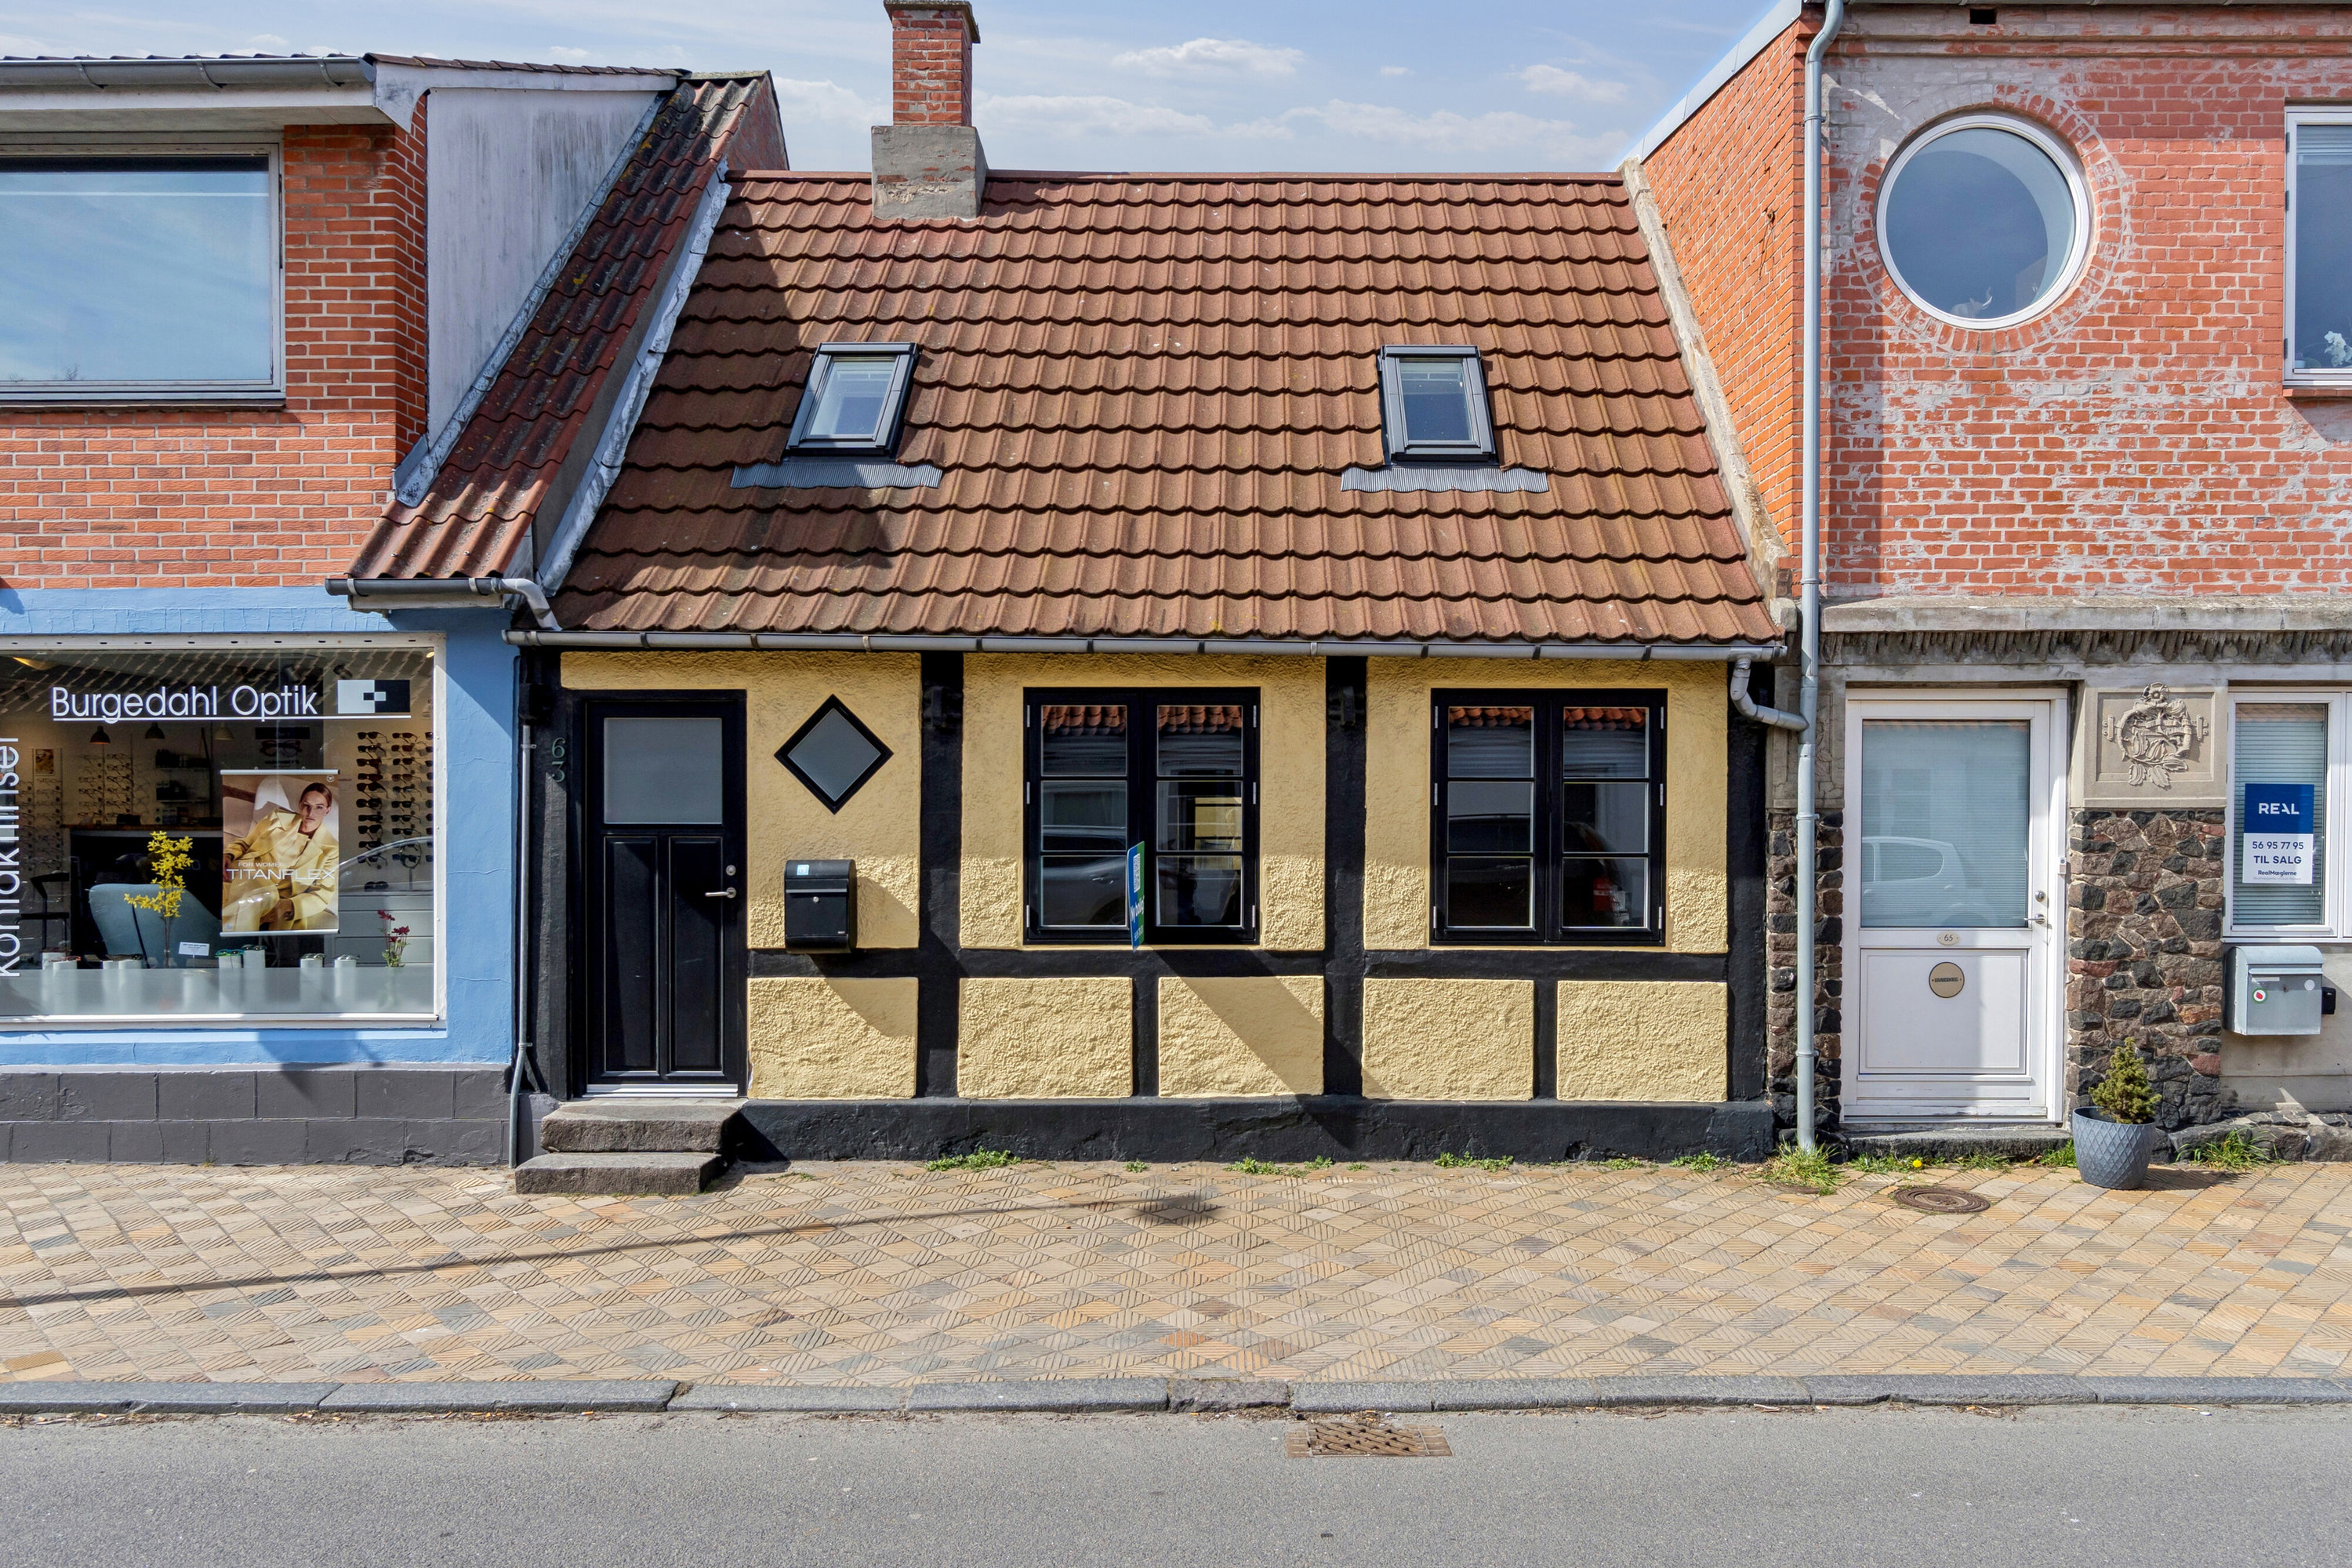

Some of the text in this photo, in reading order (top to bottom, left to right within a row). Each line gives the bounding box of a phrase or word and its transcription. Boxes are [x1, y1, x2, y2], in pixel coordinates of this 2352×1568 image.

[52, 684, 318, 724] Burgedahl Optik
[551, 737, 565, 782] 63
[2259, 803, 2299, 815] REAL
[2292, 841, 2304, 850] 95
[2253, 855, 2302, 864] TIL SALG
[226, 869, 335, 880] TITANFLEX
